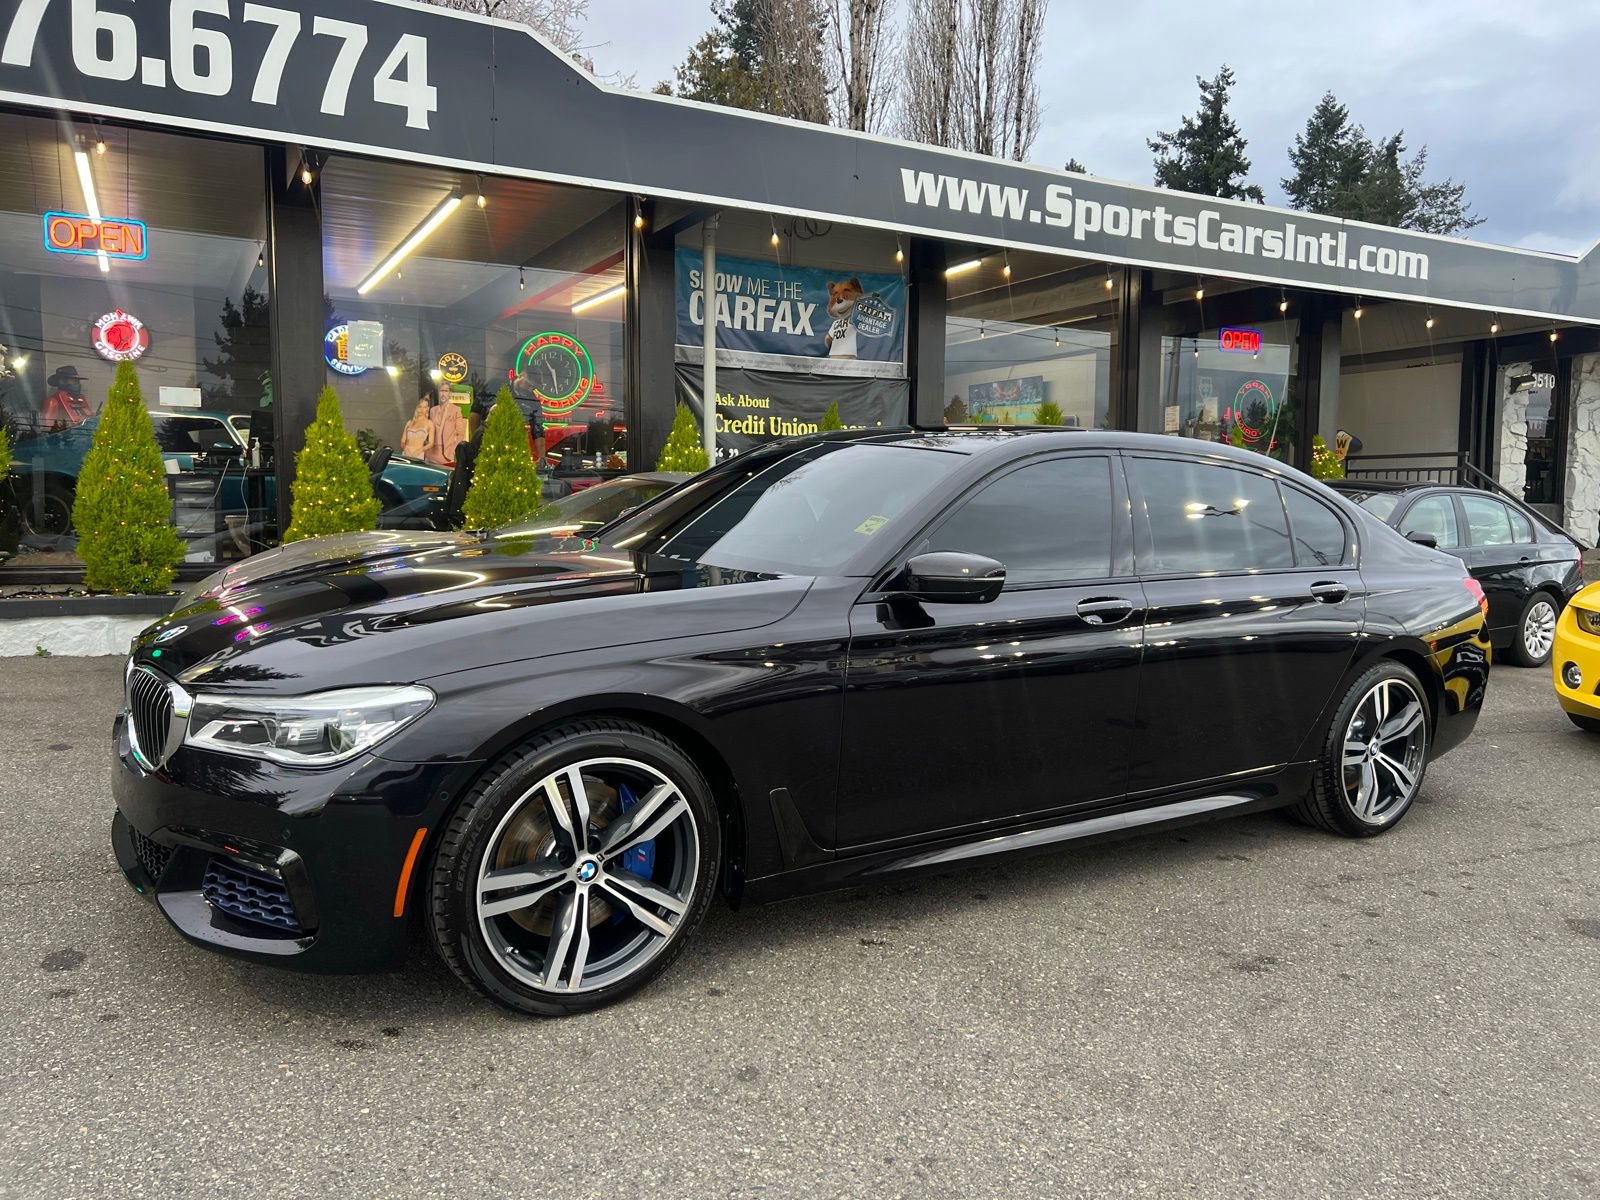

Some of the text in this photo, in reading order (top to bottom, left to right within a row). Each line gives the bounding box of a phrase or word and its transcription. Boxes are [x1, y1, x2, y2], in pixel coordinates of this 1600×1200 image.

[900, 167, 1429, 280] www.SportsCarsIntl.com
[50, 218, 142, 255] OPEN
[747, 276, 770, 297] ME
[774, 280, 802, 300] THE
[94, 312, 144, 330] MOHAWK
[689, 290, 817, 337] CARFAX
[857, 303, 892, 321] CARFAX
[834, 319, 848, 330] CAR
[857, 314, 887, 329] ADVANTAGE
[858, 322, 880, 335] DEALER
[833, 329, 847, 339] FOX
[1221, 330, 1260, 352] OPEN
[525, 335, 584, 359] HAPPY
[441, 355, 466, 368] POLLY
[715, 393, 770, 409] Ask About
[715, 413, 818, 437] Credit Union
